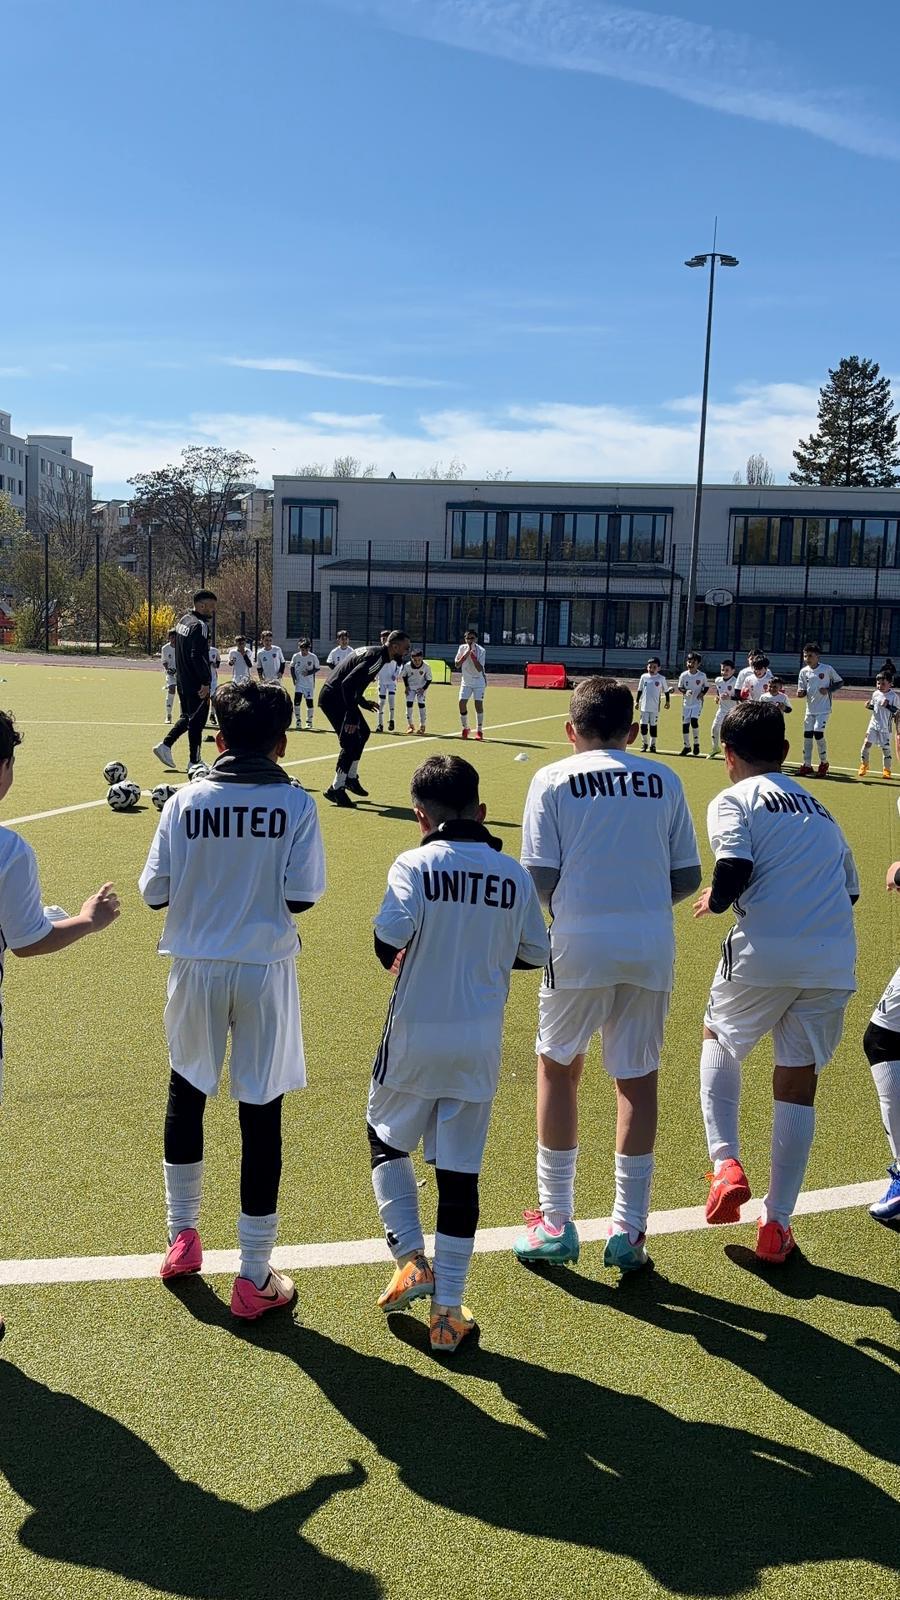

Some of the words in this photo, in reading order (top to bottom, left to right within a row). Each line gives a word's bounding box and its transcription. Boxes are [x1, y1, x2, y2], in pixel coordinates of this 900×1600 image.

[569, 770, 663, 800] UNITED
[185, 806, 287, 840] UNITED
[423, 870, 517, 910] UNITED
